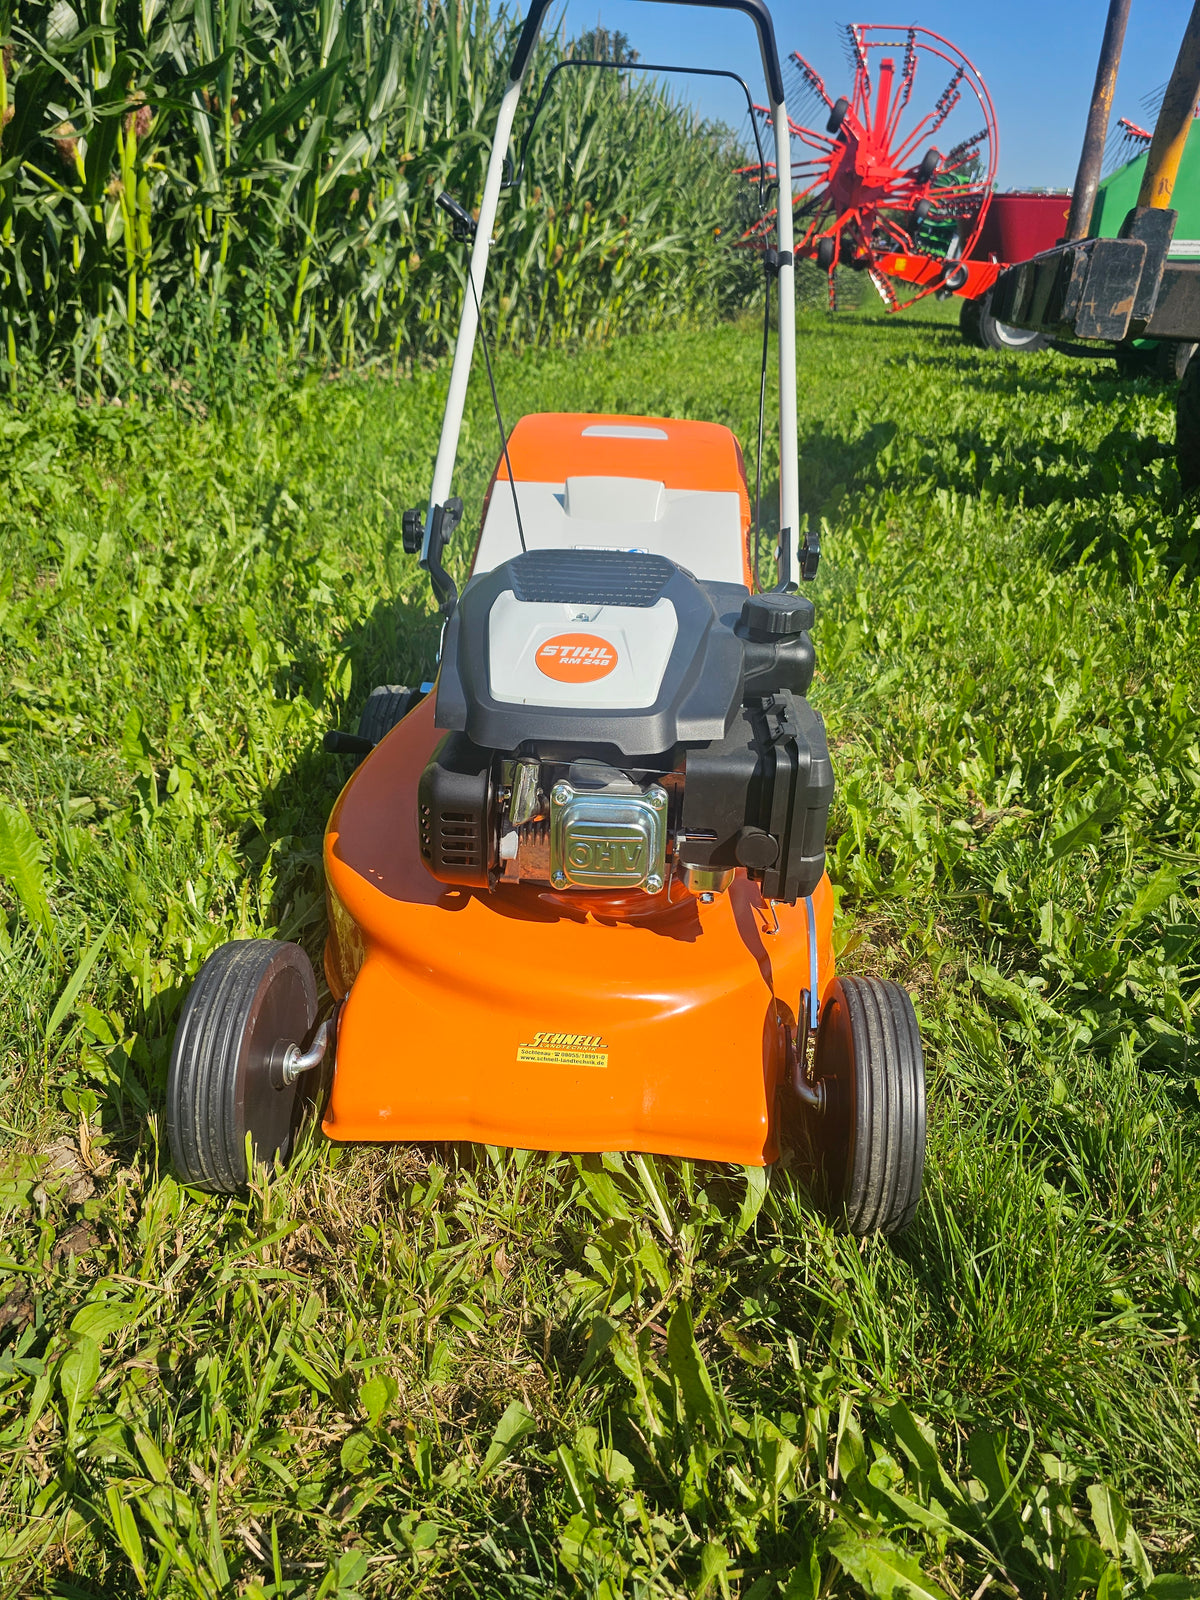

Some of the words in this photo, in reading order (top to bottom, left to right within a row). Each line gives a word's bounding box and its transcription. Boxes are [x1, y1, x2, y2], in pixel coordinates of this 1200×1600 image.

[540, 646, 612, 659] STIHL
[569, 842, 642, 871] OHV
[527, 1032, 602, 1047] SCHNELL
[540, 1043, 598, 1052] LANDTECHNIK
[520, 1055, 605, 1066] www.schnell-landtechnik.de
